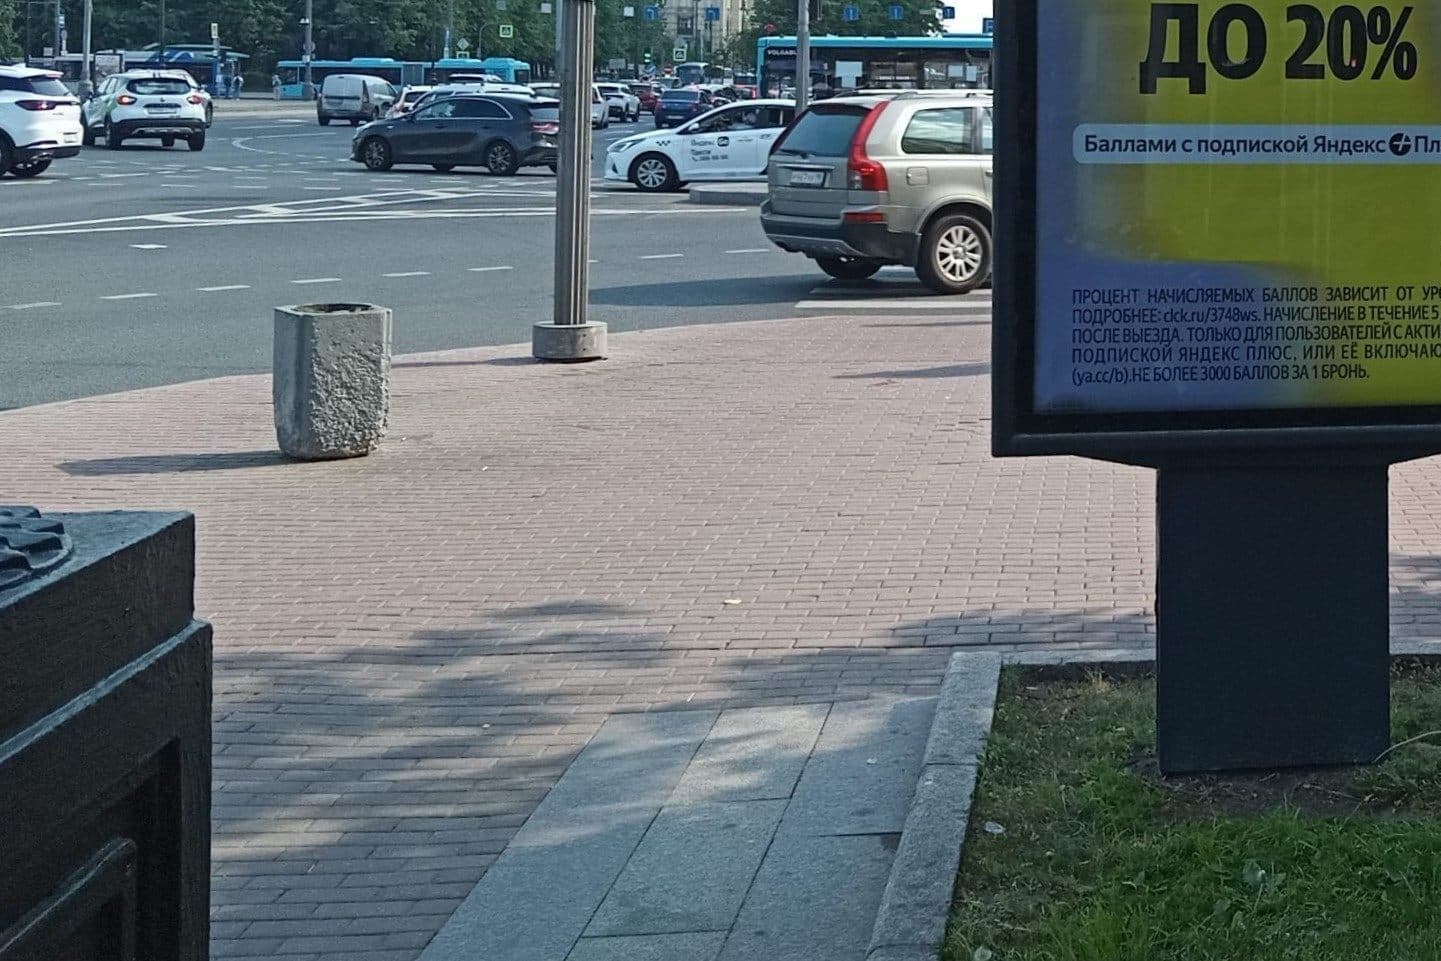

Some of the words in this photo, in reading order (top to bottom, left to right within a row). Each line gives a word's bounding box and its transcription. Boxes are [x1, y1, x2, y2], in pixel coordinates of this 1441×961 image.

[1138, 2, 1268, 96] ДО
[1284, 3, 1418, 82] 20%
[1084, 135, 1177, 153] Баллами
[1181, 140, 1193, 153] с
[1197, 135, 1308, 156] подпиской
[1312, 136, 1386, 156] Яндекс
[1072, 288, 1140, 306] ПРОЦЕНТ
[1147, 288, 1254, 304] НАЧИСЛЯЕМЫХ
[1262, 287, 1318, 302] БАЛЛОВ
[1326, 287, 1389, 301] ЗАВИСИТ
[1396, 286, 1415, 301] ОТ
[1072, 308, 1162, 326] ПОДРОБНЕЕ:
[1264, 306, 1355, 321] НАЧИСЛЕНИЕ
[1357, 306, 1366, 321] В
[1369, 305, 1430, 320] ТЕЧЕНИЕ
[1431, 304, 1439, 320] 5
[1072, 328, 1122, 344] ПОСЛЕ
[1123, 327, 1184, 346] ВЫЕЗДА.
[1187, 326, 1242, 342] ТОЛЬКО
[1244, 326, 1273, 344] ДЛЯ
[1276, 322, 1391, 340] ПОЛЬЗОВАТЕЛЕЙ
[1393, 324, 1403, 339] С
[1072, 345, 1173, 365] ПОДПИСКОЙ
[1179, 346, 1240, 364] ЯНДЕКС
[1246, 345, 1297, 361] ПЛЮС,
[1303, 344, 1335, 360] ИЛИ
[1342, 341, 1358, 359] ЕЁ
[1153, 366, 1199, 382] БОЛЕЕ
[1201, 365, 1231, 381] 3000
[1233, 364, 1290, 380] БАЛЛОВ
[1292, 364, 1309, 380] ЗА
[1312, 364, 1318, 379] 1
[1321, 363, 1370, 380] БРОНЬ.
